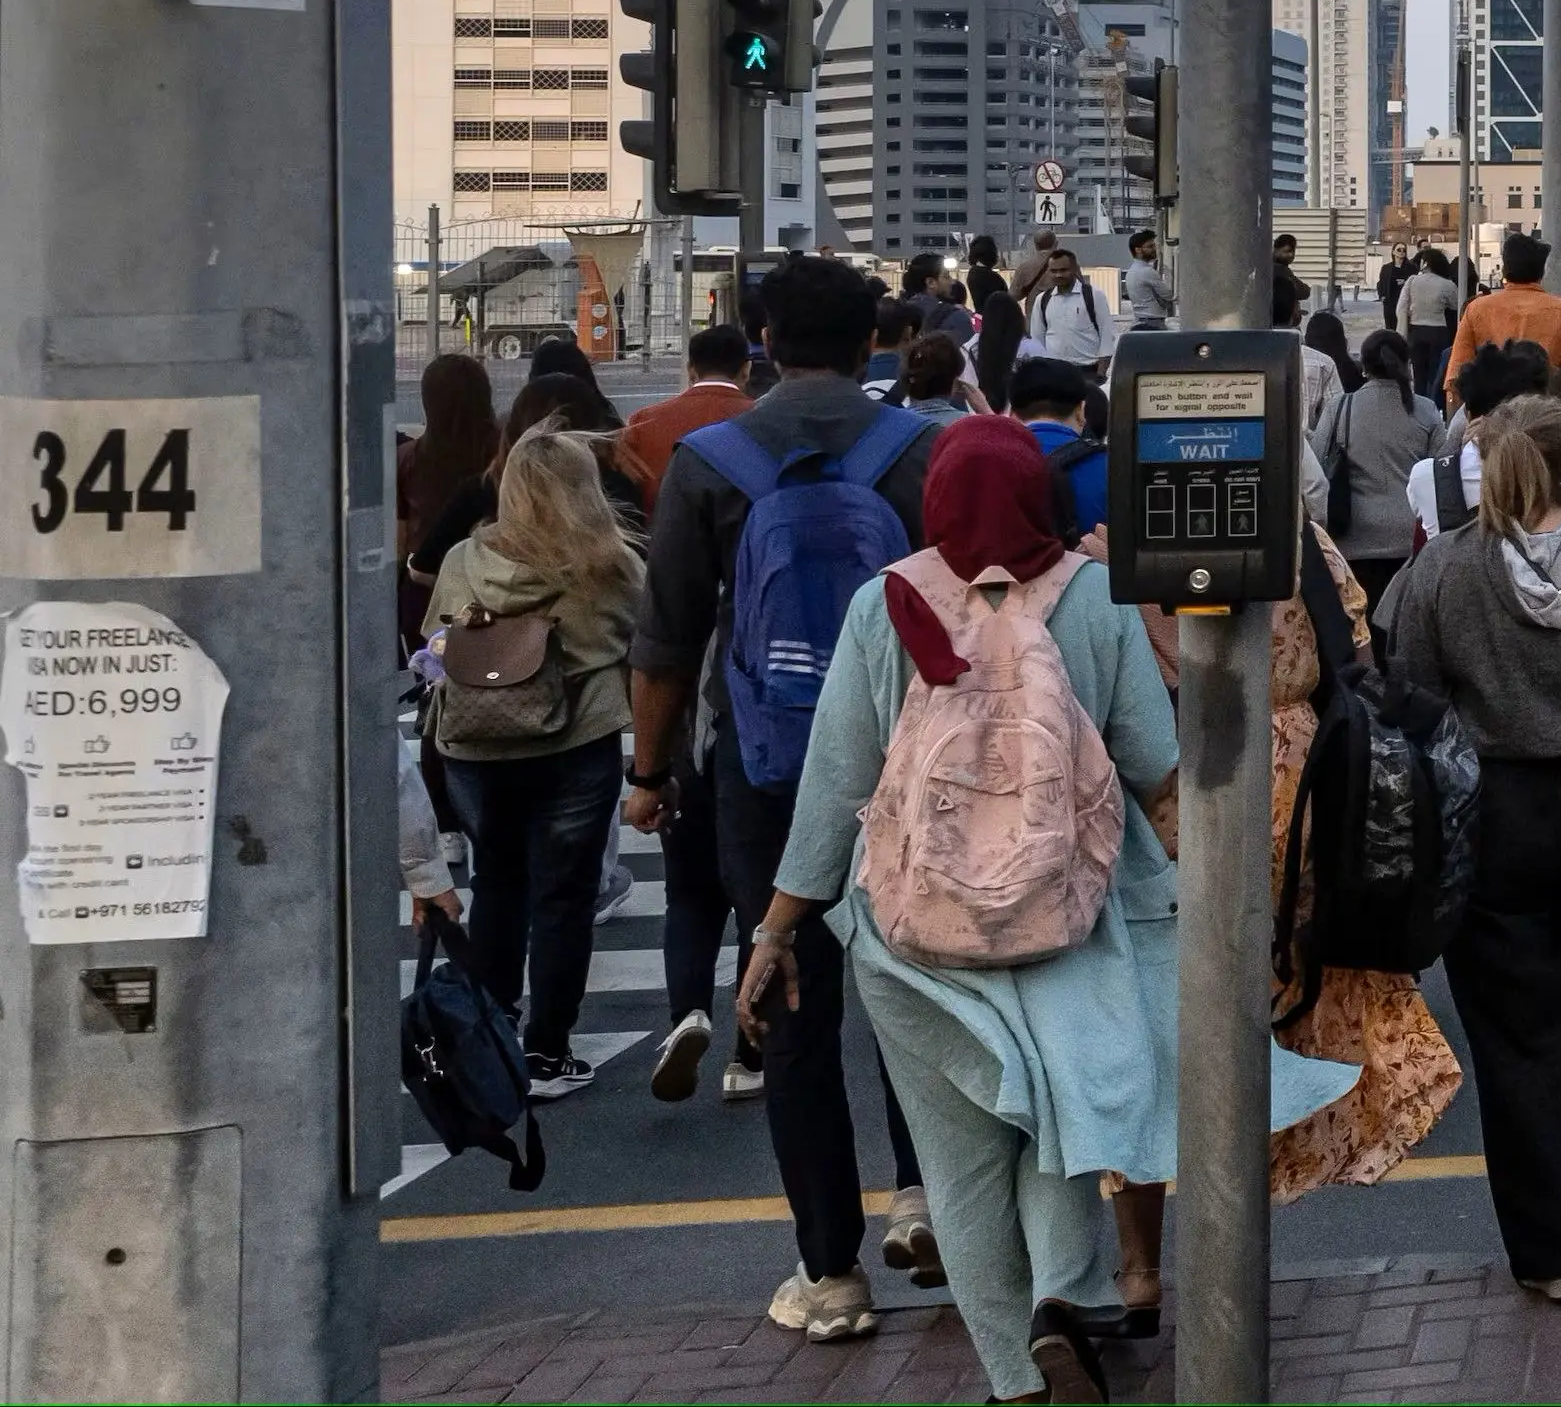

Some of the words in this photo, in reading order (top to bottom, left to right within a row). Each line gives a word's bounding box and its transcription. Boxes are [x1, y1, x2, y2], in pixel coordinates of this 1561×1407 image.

[1149, 393, 1172, 402] push
[1178, 392, 1207, 400] button
[1212, 392, 1230, 400] and
[1234, 392, 1253, 400] wait
[1156, 403, 1169, 411] for
[1174, 403, 1202, 412] signal
[1206, 403, 1247, 412] opposite
[1180, 444, 1230, 460] WAIT
[31, 428, 196, 534] 344
[52, 655, 98, 676] NOW
[102, 655, 121, 674] IN
[125, 653, 178, 674] JUST:
[91, 904, 127, 918] +971
